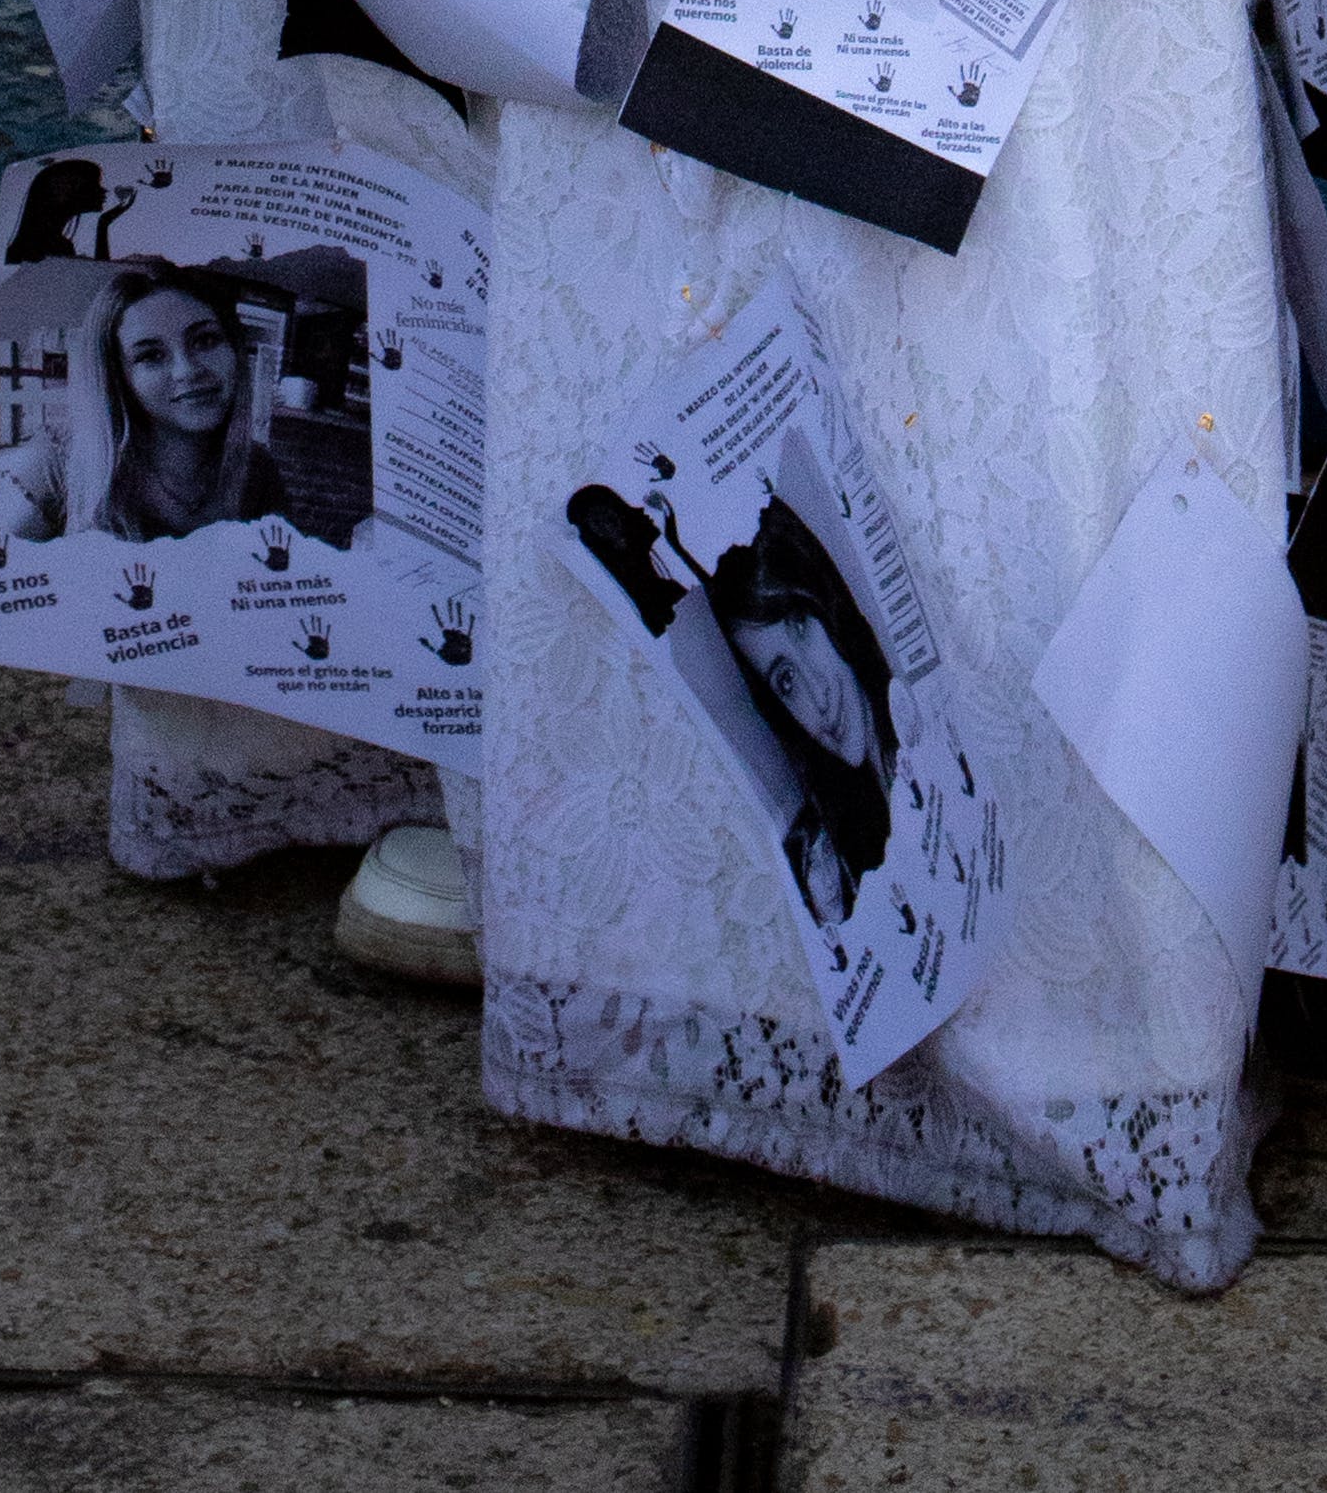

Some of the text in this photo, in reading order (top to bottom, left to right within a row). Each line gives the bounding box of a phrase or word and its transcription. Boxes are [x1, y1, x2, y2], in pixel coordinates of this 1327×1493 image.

[11, 573, 50, 591] nos
[102, 612, 192, 644] Basta de
[105, 631, 200, 664] violencia
